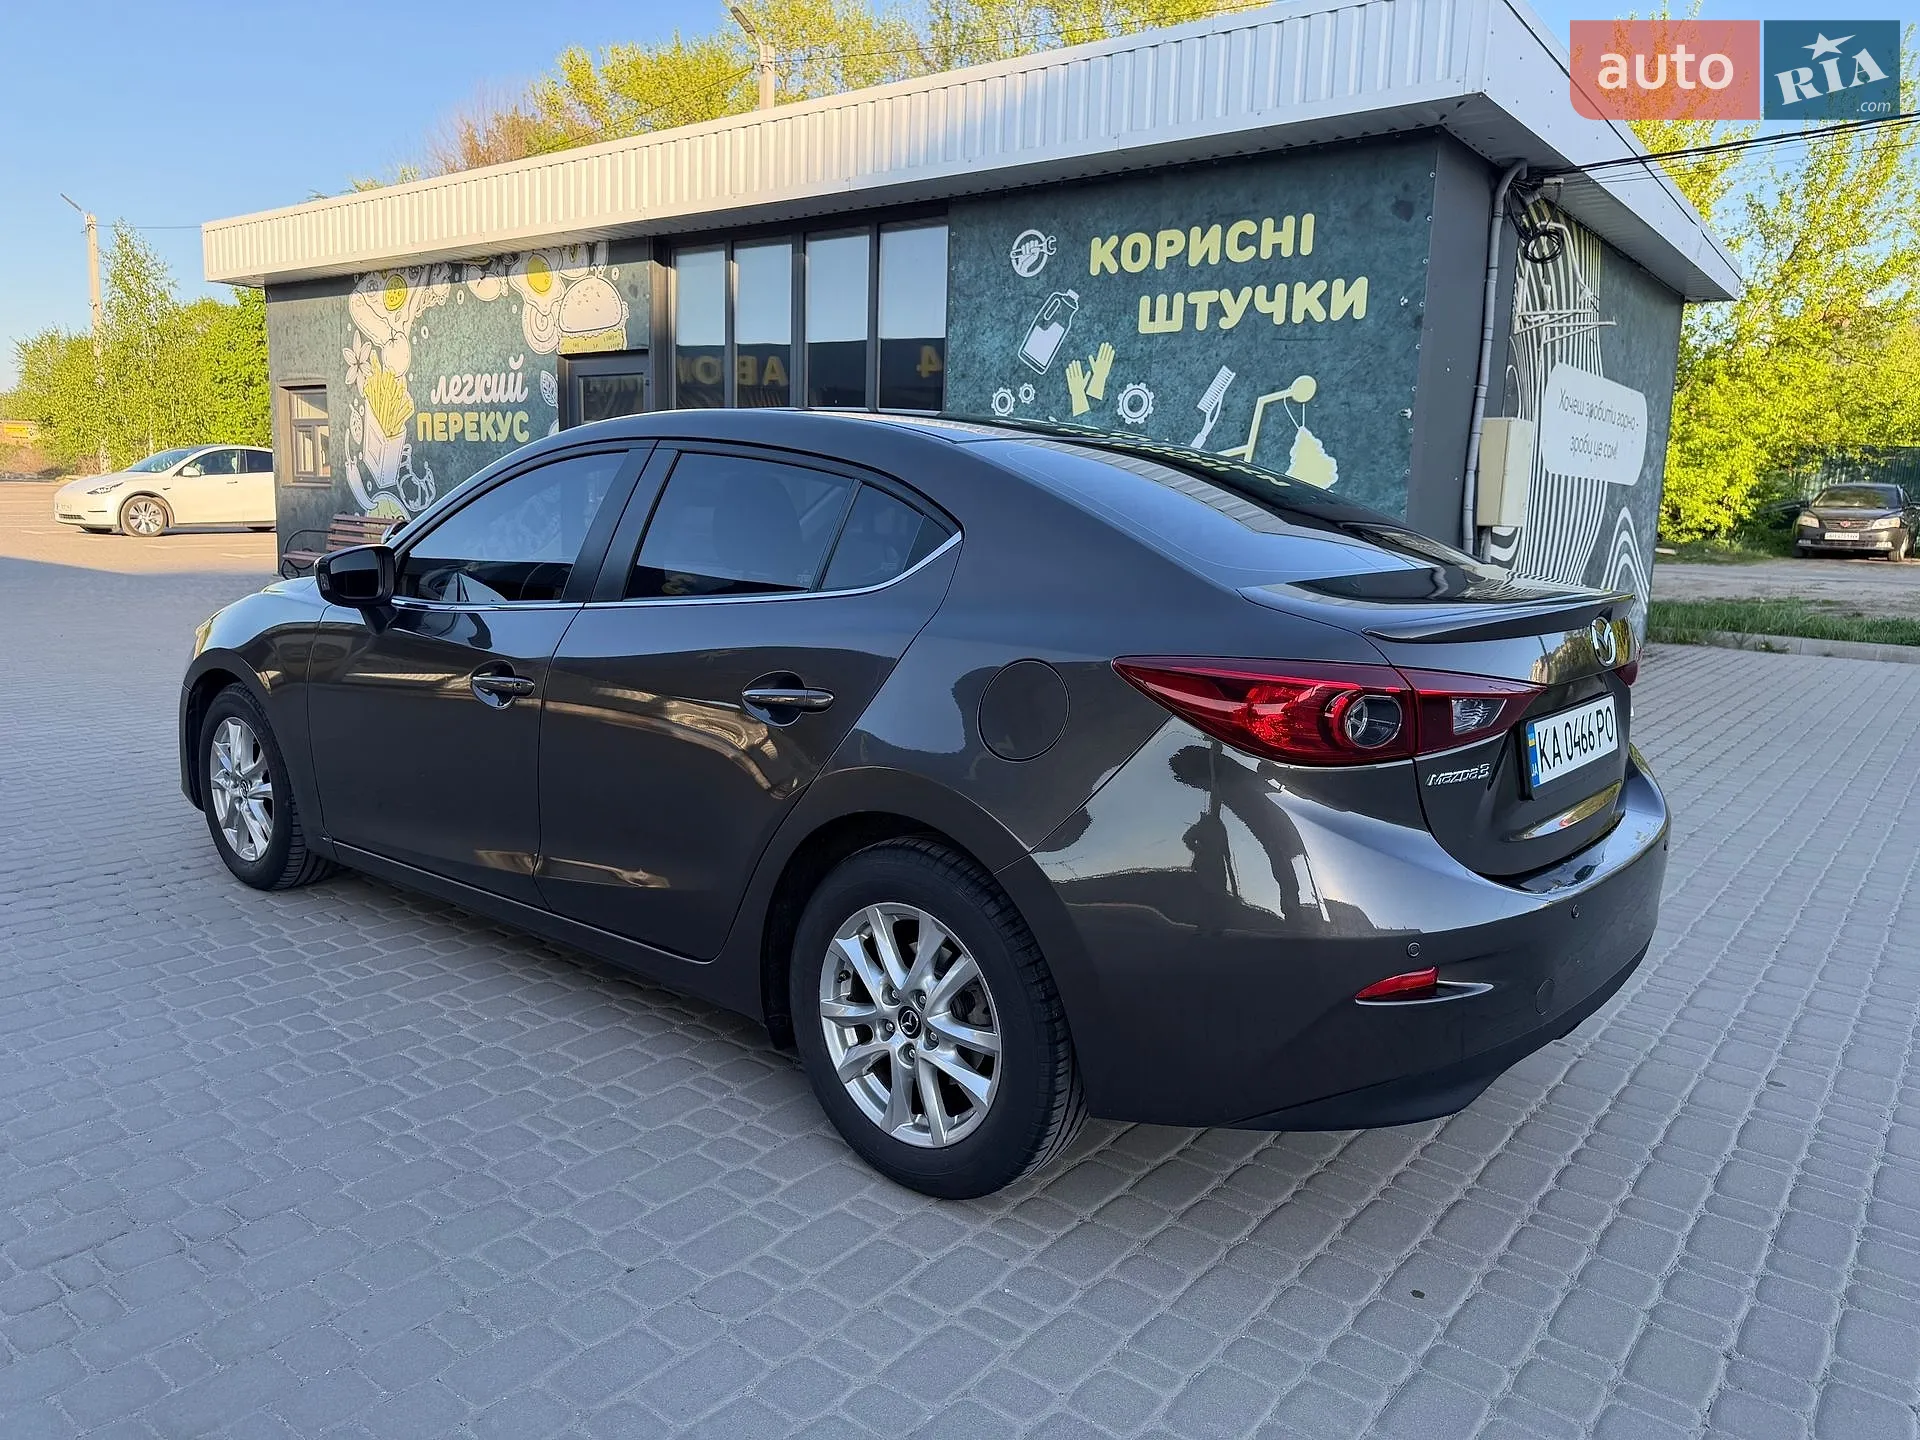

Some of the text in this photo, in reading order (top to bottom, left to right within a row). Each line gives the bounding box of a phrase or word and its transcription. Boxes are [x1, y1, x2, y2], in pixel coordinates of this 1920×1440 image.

[1090, 213, 1315, 276] КОРИСНІ
[1138, 276, 1369, 334] ШТУЧКИ
[416, 411, 530, 442] ПЕРЕКУС
[1564, 712, 1596, 761] 0466
